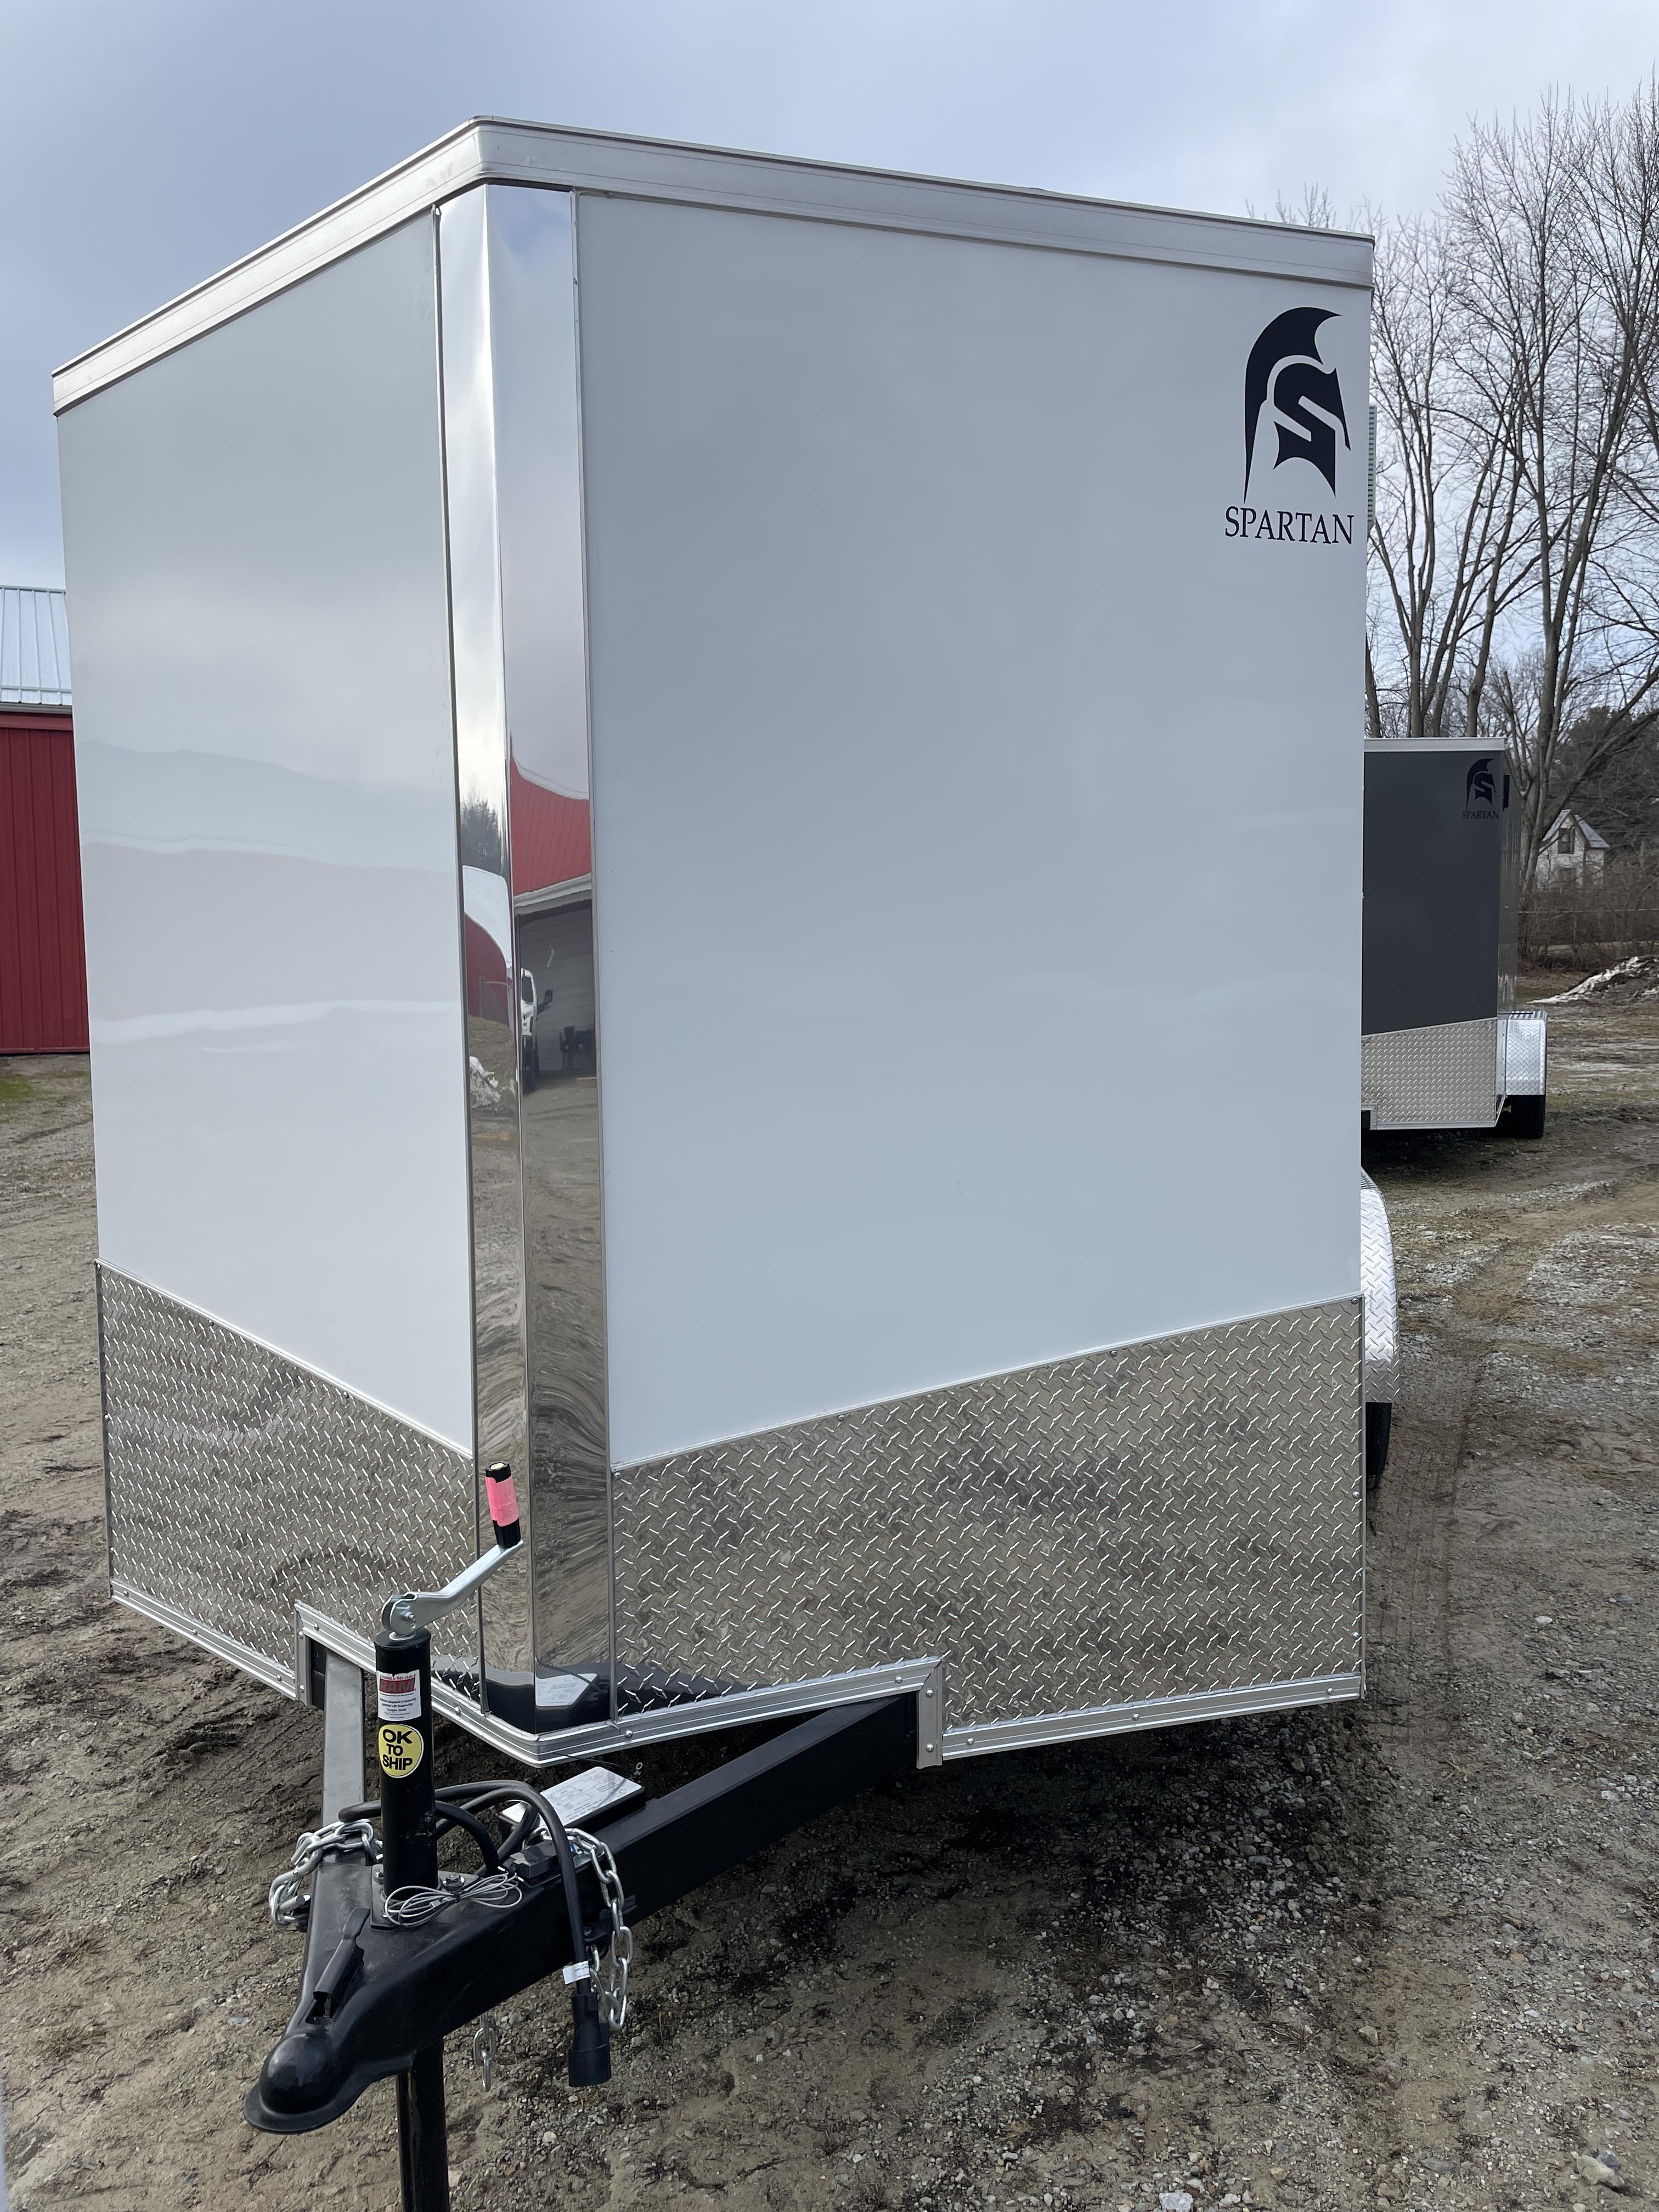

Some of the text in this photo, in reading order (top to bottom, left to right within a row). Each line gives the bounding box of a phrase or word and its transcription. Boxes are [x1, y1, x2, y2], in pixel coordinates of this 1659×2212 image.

[1225, 505, 1354, 544] SPARTAN
[1462, 810, 1499, 819] SPARTAN
[380, 1679, 414, 1694] RAM
[382, 1729, 413, 1744] OK
[386, 1743, 404, 1757] TO
[382, 1754, 413, 1770] SHIP
